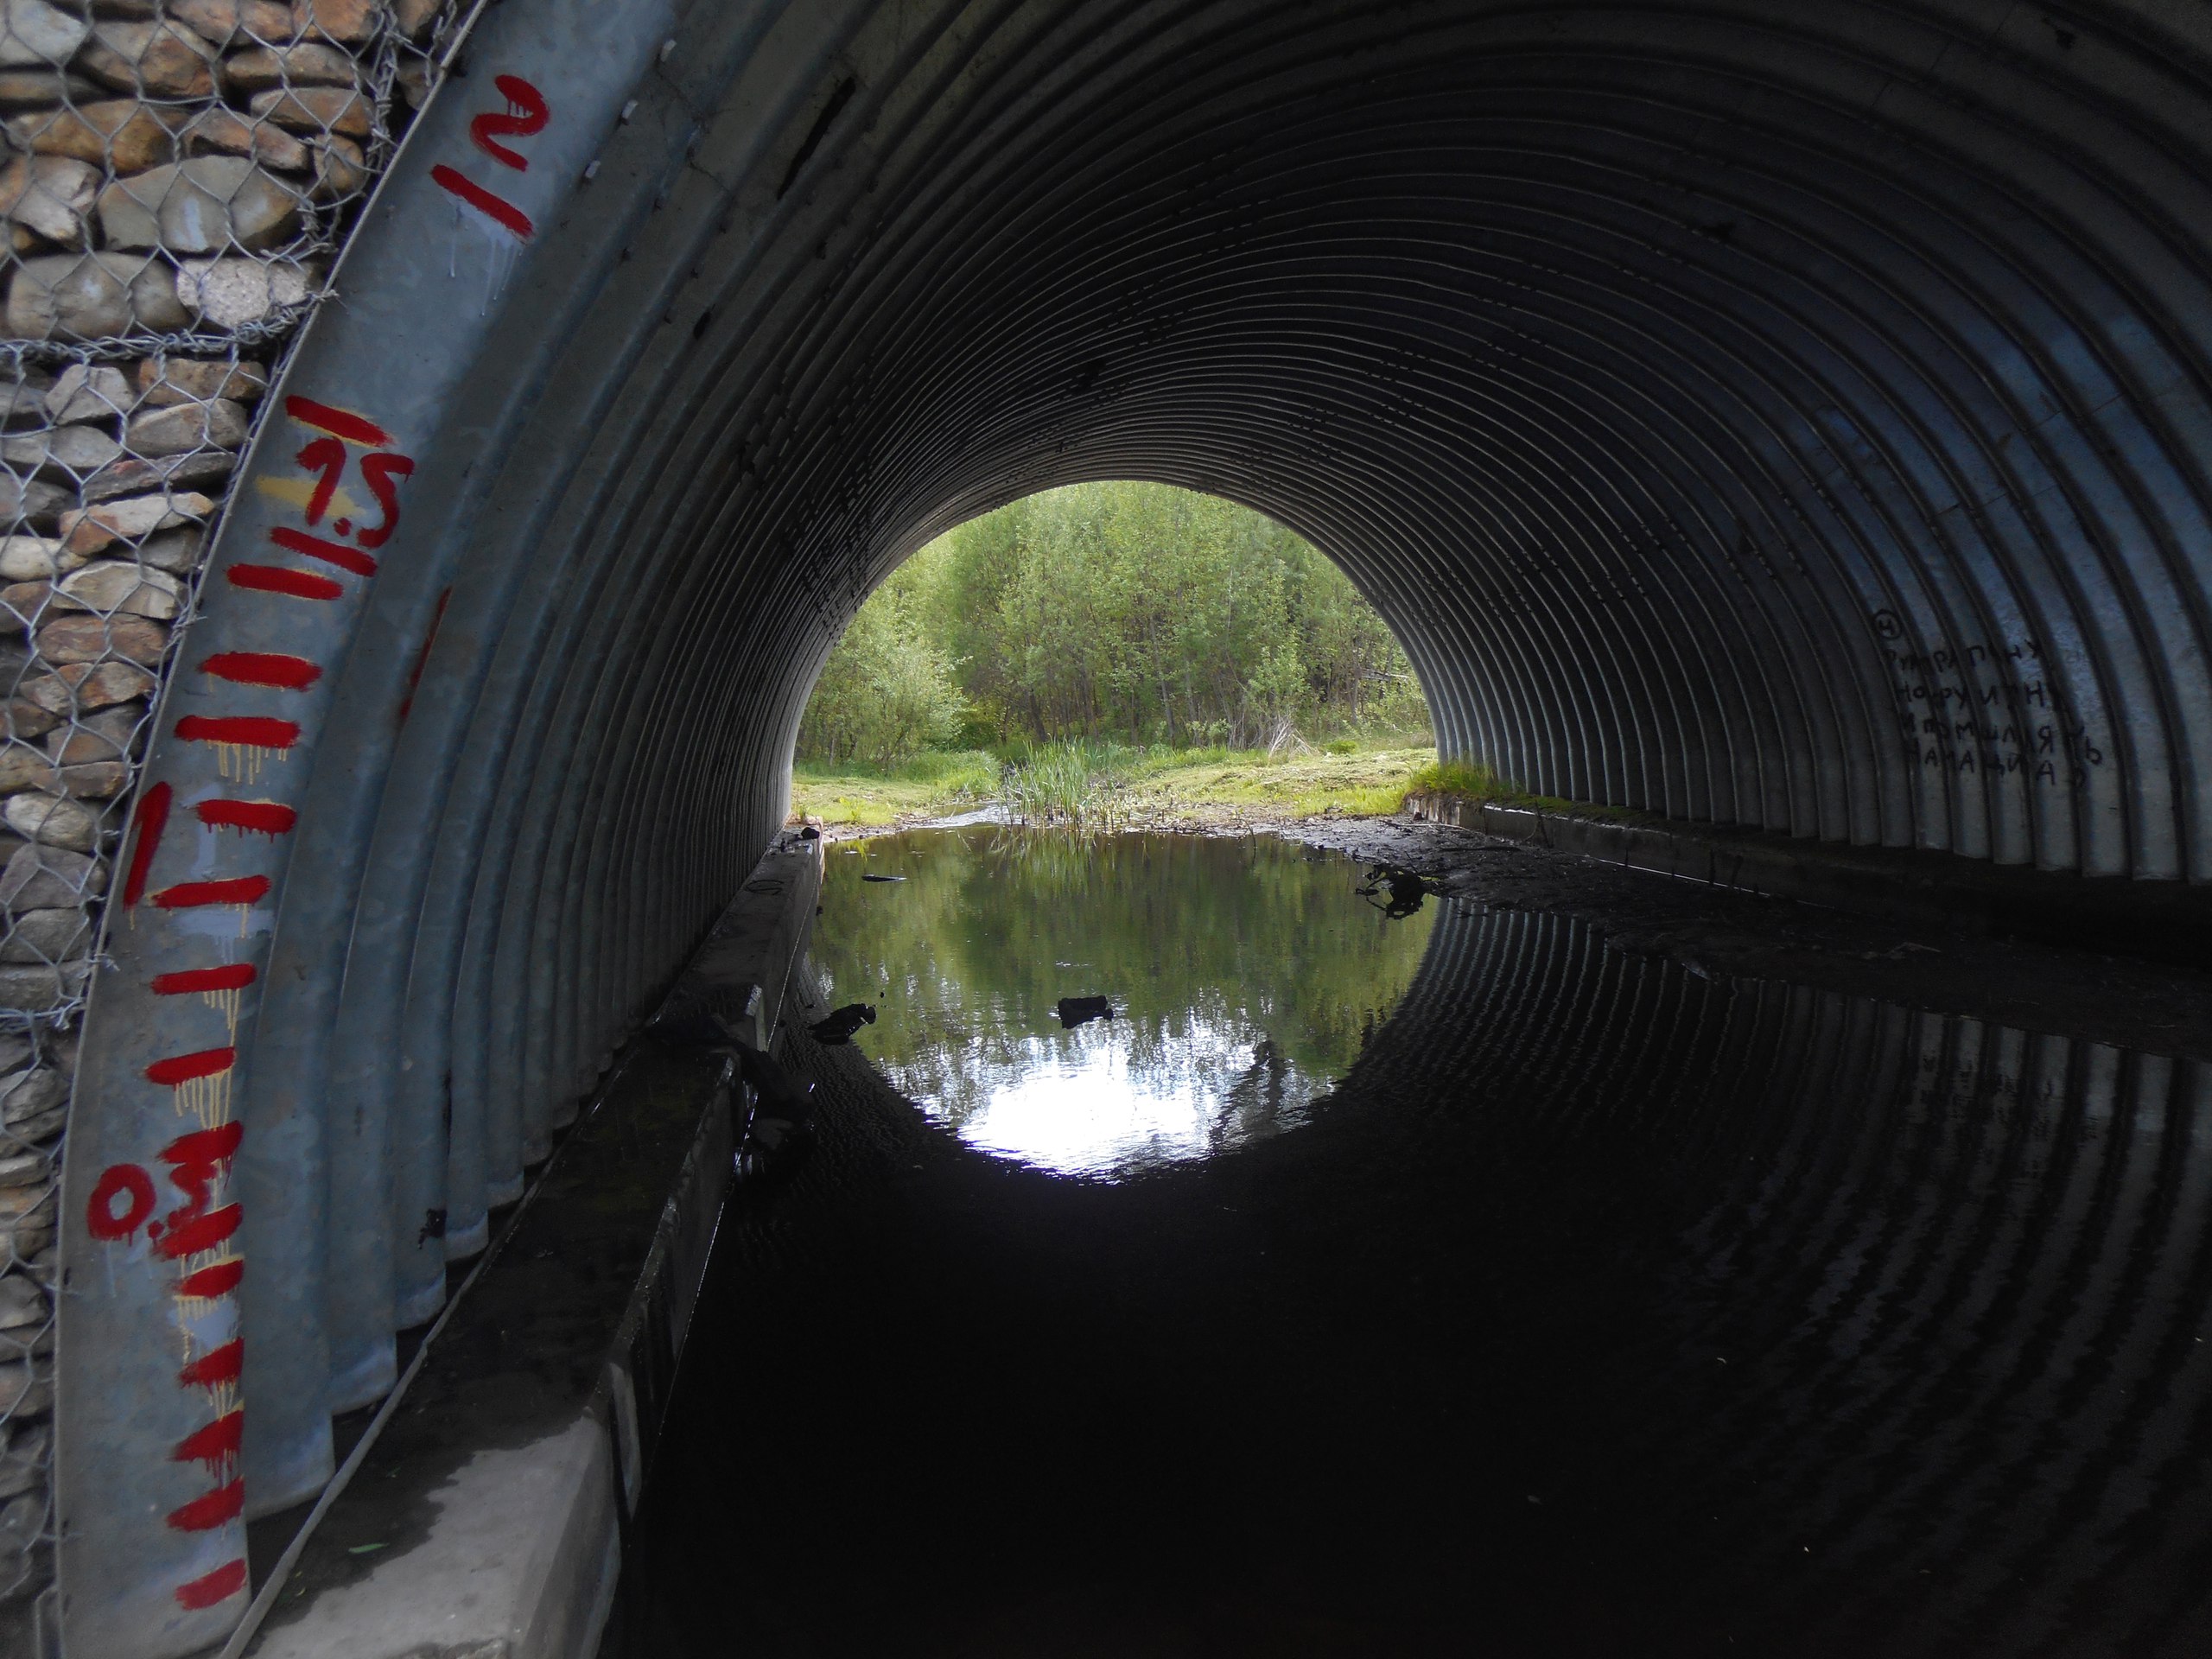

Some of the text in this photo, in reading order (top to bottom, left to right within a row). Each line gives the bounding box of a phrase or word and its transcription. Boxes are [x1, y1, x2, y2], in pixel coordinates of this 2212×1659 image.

[469, 74, 550, 172] 2
[296, 436, 415, 549] 1.5
[124, 781, 172, 913] 1
